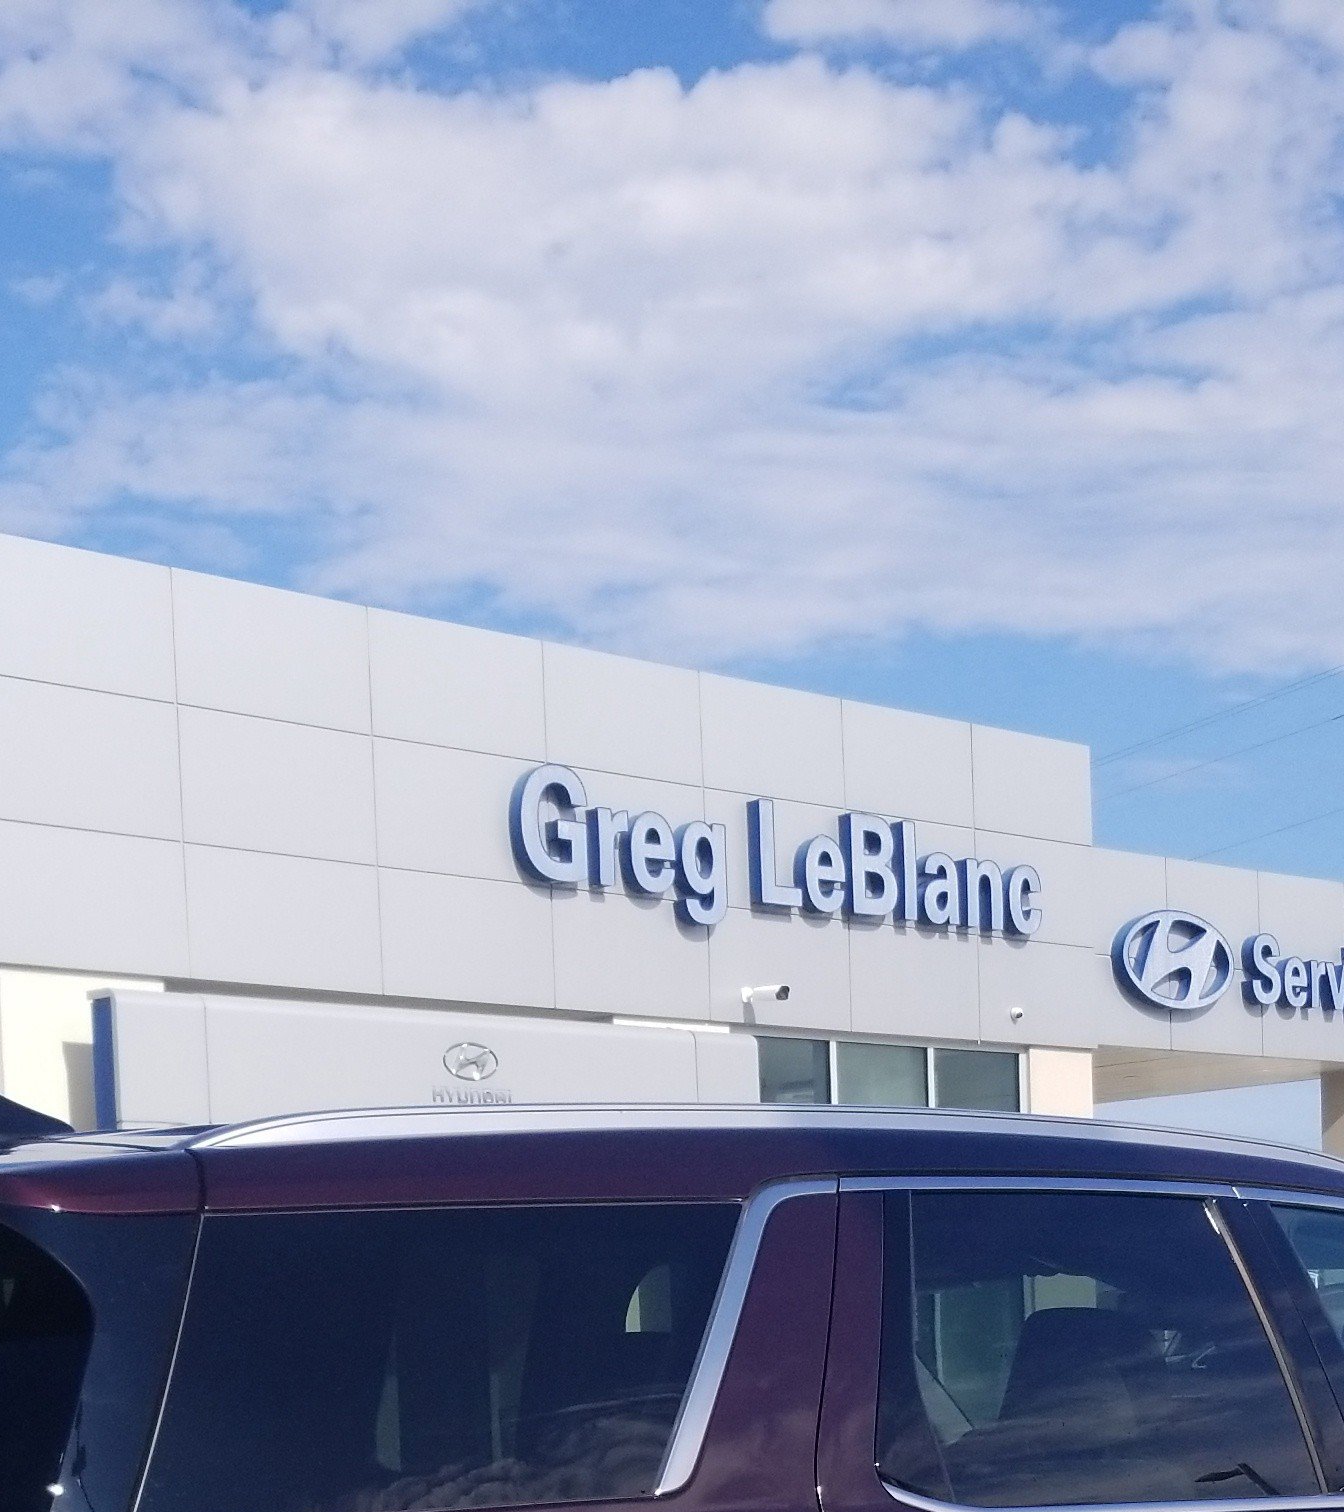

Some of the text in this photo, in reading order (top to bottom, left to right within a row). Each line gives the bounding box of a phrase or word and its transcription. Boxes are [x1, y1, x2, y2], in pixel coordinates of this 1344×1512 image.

[509, 764, 1043, 935] Greg LeBlanc
[431, 1088, 512, 1104] HYUNDAI
